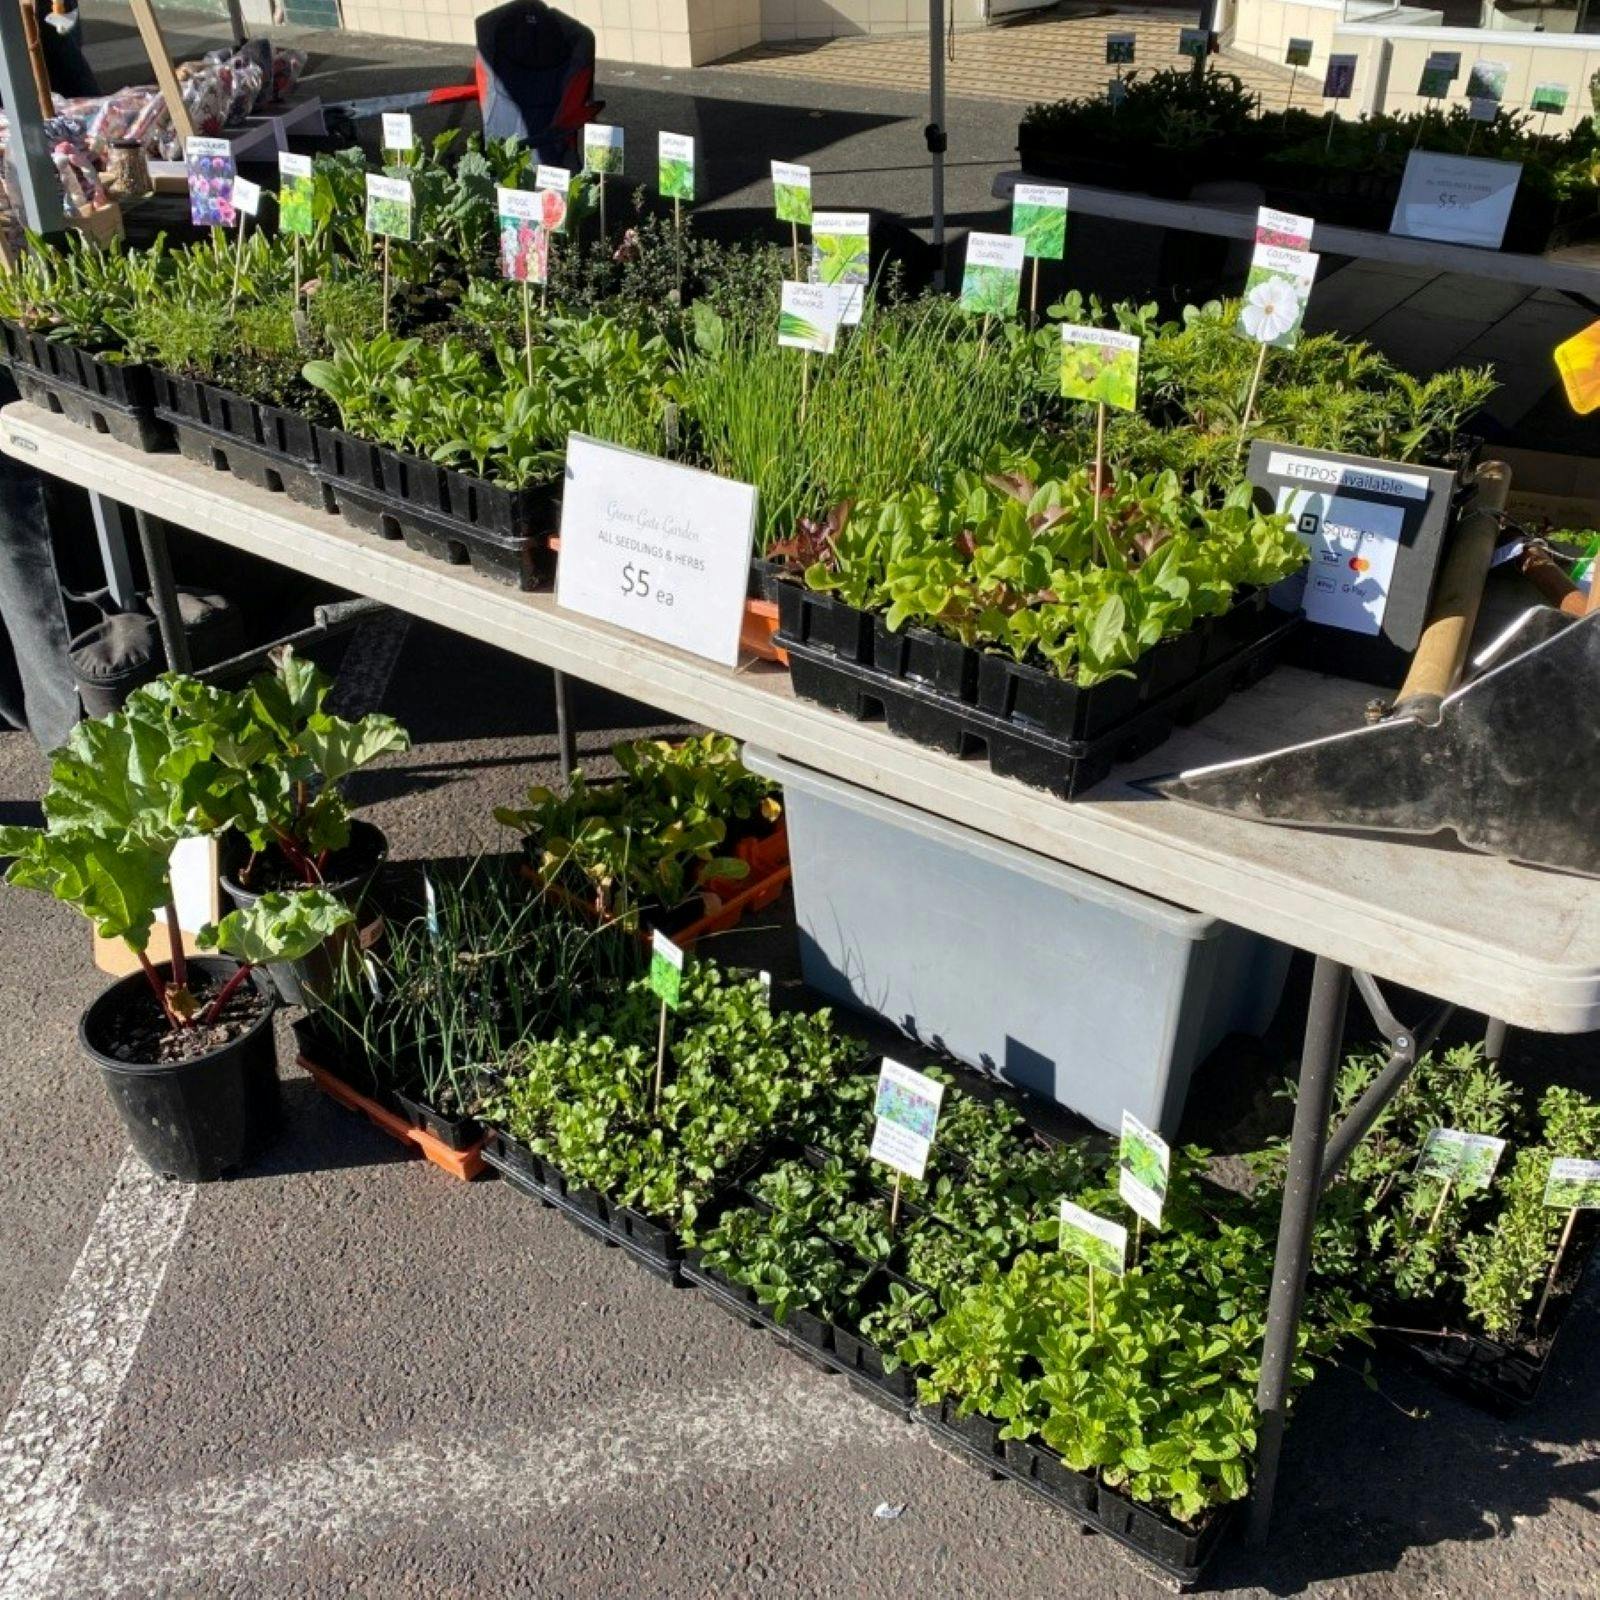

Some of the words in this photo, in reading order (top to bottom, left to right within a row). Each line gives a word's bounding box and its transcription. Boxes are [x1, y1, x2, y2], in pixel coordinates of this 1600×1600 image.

[1286, 462, 1338, 483] EFTPOS
[1340, 472, 1404, 495] available
[607, 499, 634, 522] Green
[637, 507, 660, 530] Gate
[662, 516, 700, 541] Garden
[598, 529, 613, 544] ALL
[615, 534, 663, 558] SEEDLINGS
[665, 549, 673, 562] &
[675, 553, 706, 572] HERBS
[620, 560, 650, 598] $5
[656, 588, 675, 607] ea
